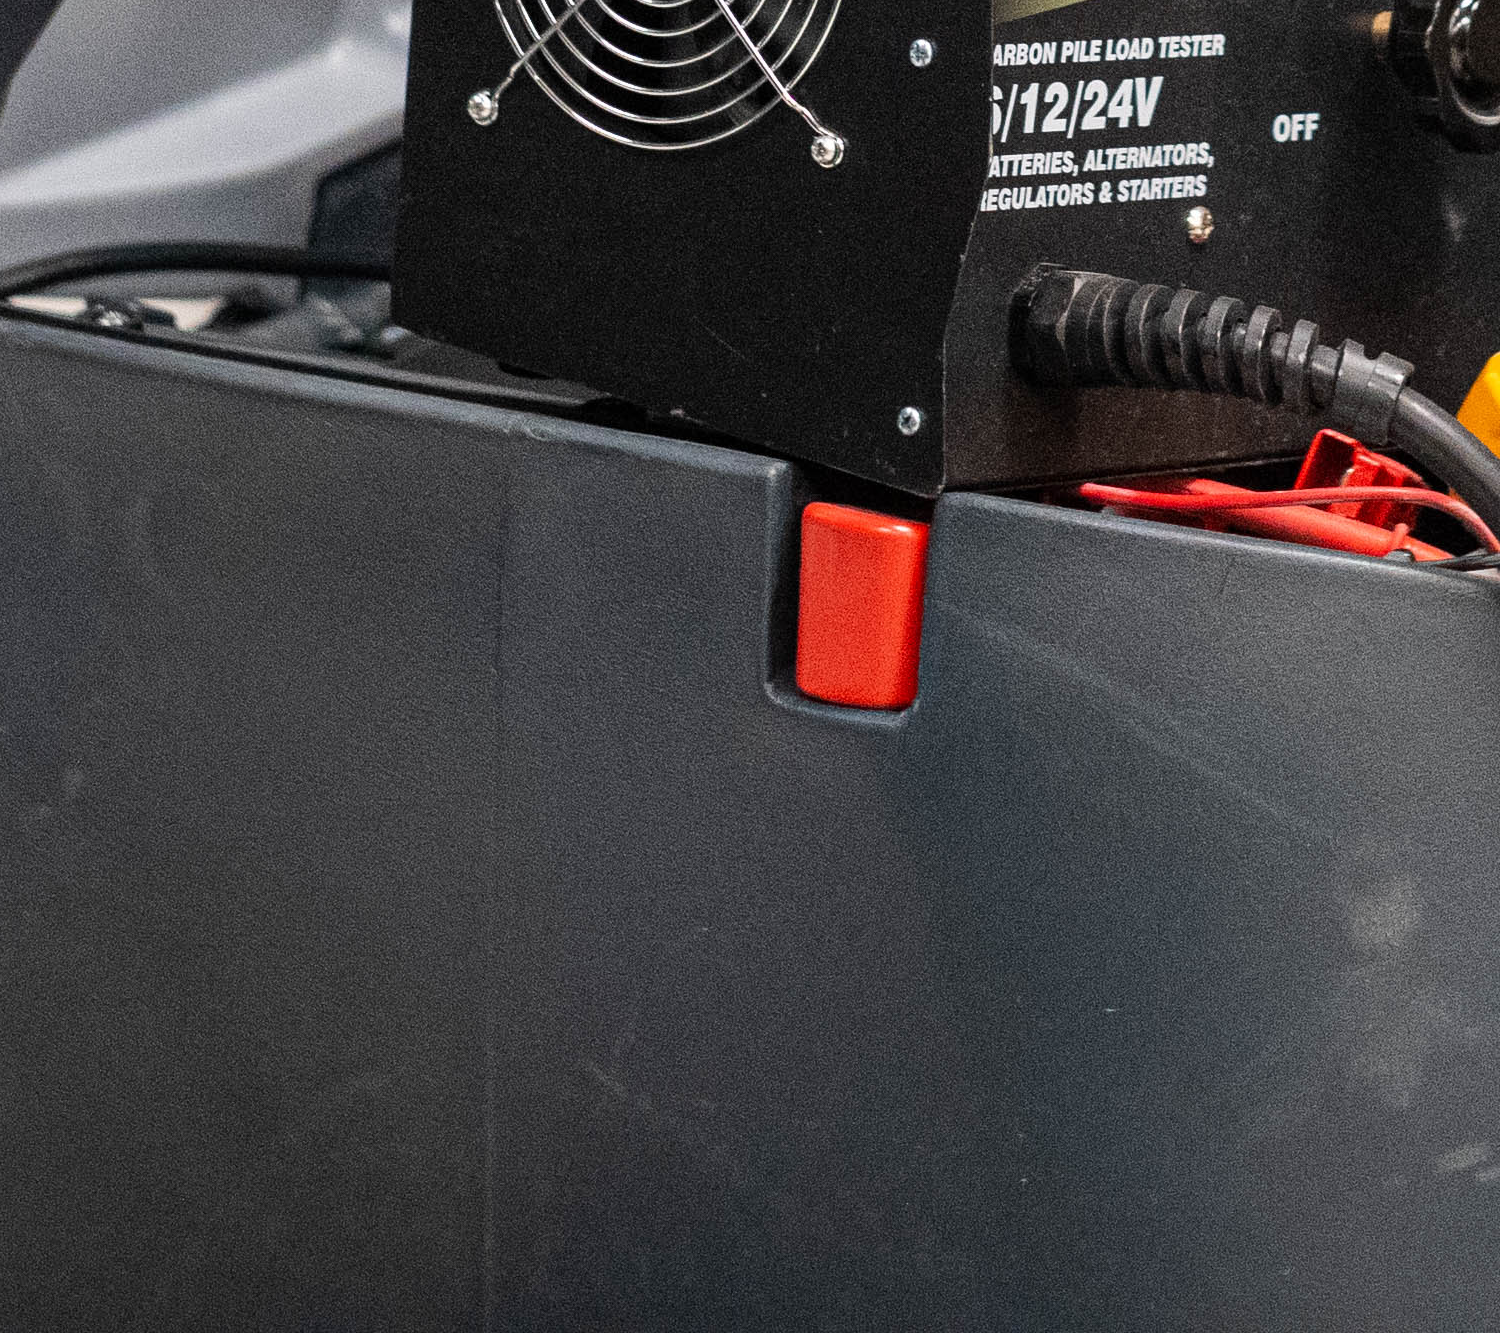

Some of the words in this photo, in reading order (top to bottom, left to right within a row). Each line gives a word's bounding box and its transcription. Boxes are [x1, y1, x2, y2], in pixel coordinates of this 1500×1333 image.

[993, 41, 1057, 66] ARBON
[1060, 39, 1102, 63] PILE
[1104, 37, 1154, 62] LOAD
[1158, 34, 1226, 59] TESTER
[1272, 113, 1320, 143] OFF
[988, 150, 1079, 178] ATTERIES,
[1082, 142, 1215, 172] ALTERNATORS,
[1098, 181, 1112, 204] &
[1116, 174, 1208, 202] STARTERS
